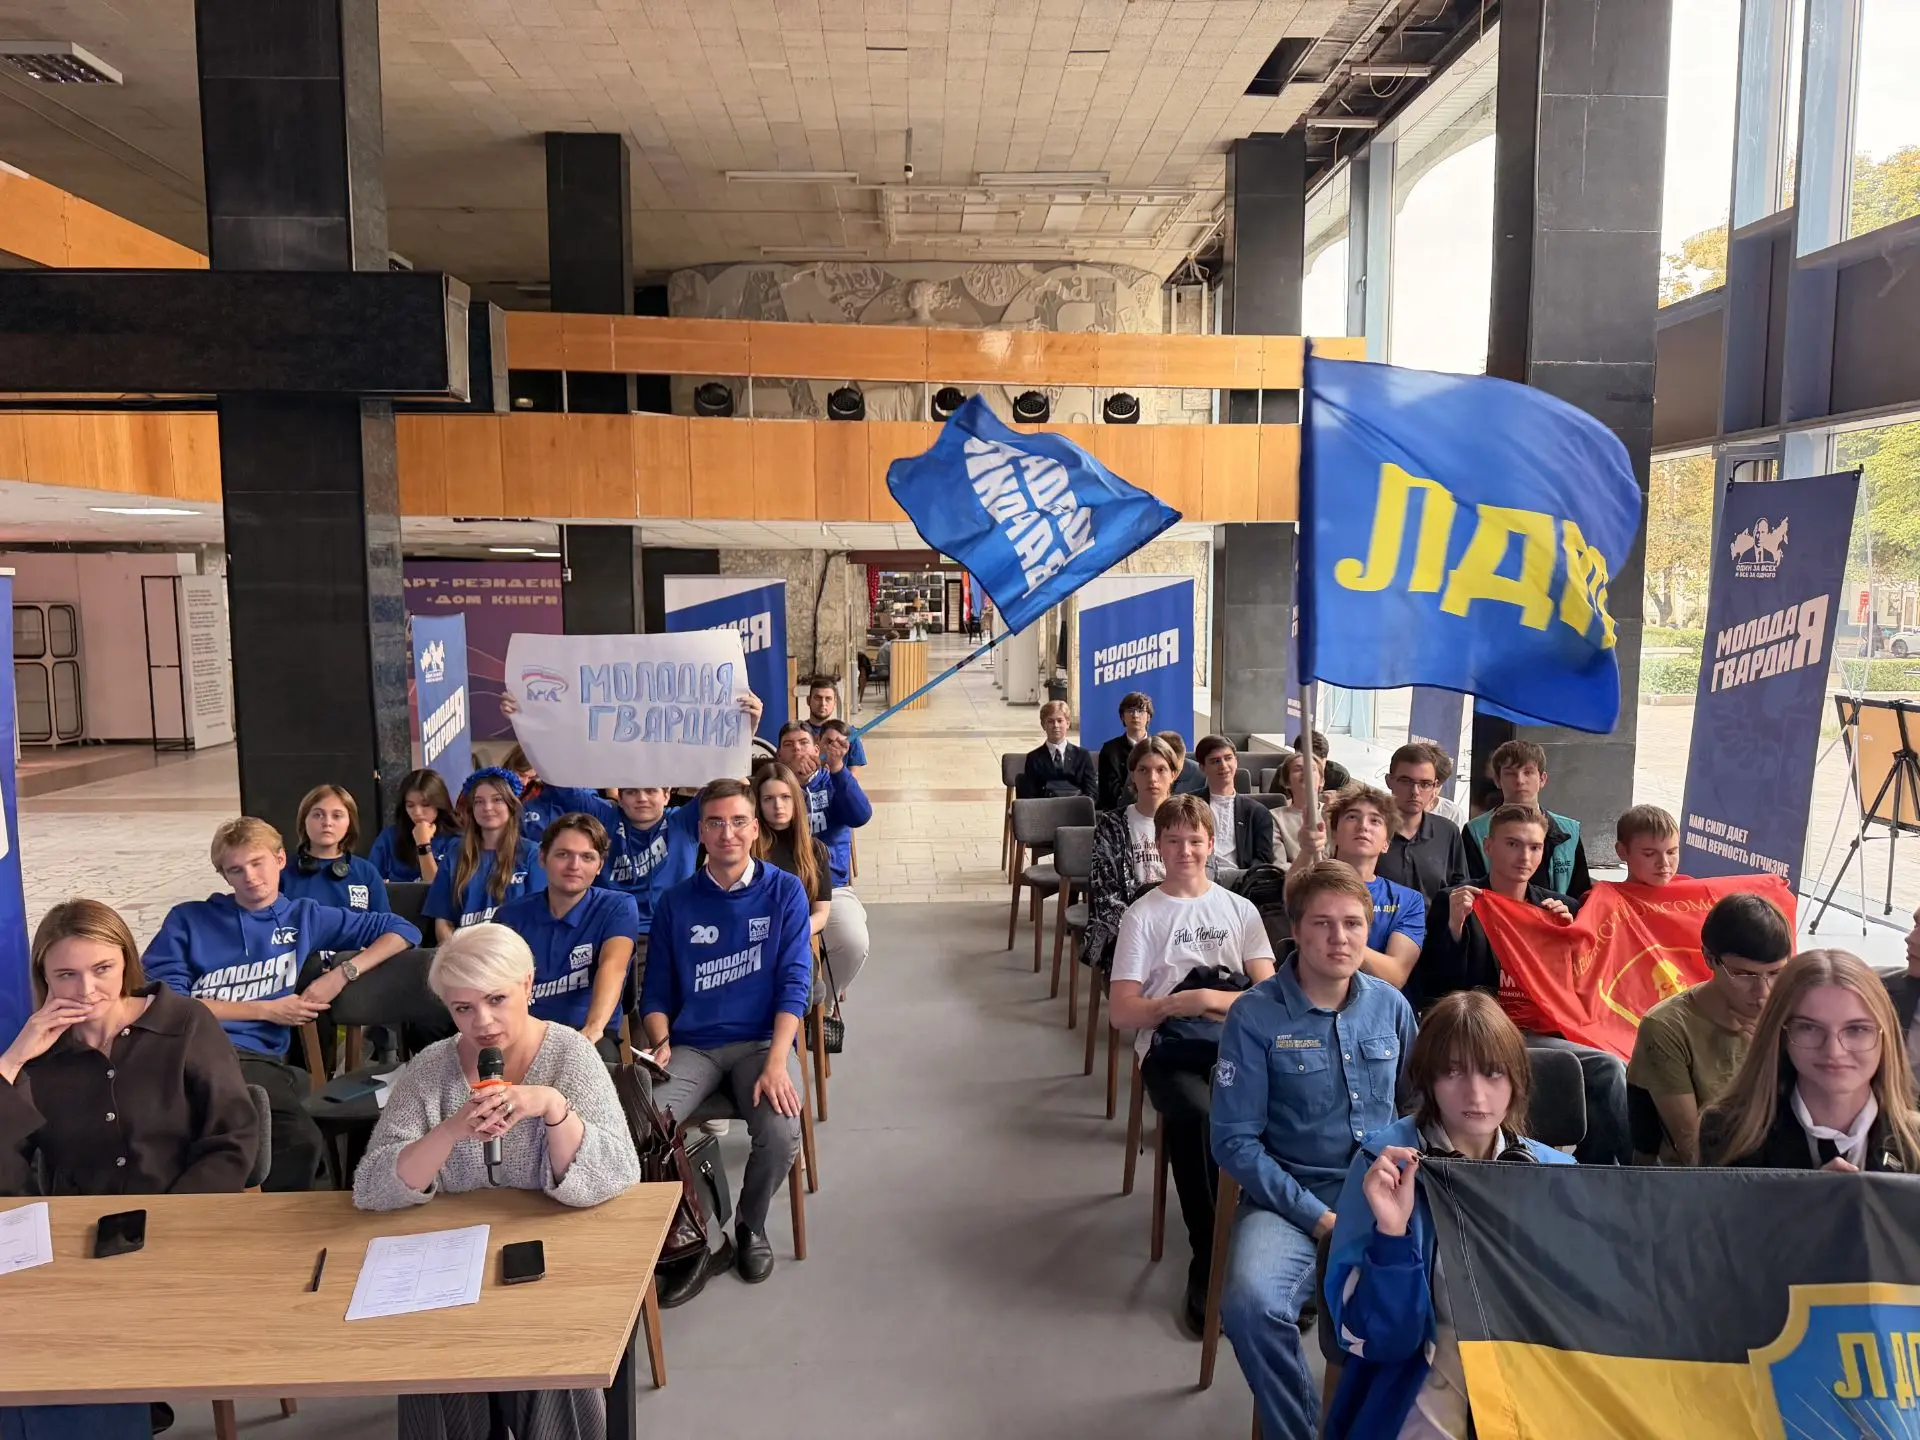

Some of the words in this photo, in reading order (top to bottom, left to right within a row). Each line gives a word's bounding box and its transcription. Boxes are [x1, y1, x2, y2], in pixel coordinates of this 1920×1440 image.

[1761, 564, 1776, 572] ВСЕХ
[1716, 594, 1829, 659] МОЛОДАЯ
[1095, 628, 1179, 667] МОЛОДАЯ
[580, 662, 733, 705] МОЛОДАЯ
[588, 704, 742, 748] ГВАРДИЯ
[1688, 813, 1705, 831] НАМ
[1705, 819, 1727, 837] СИЛУ
[1726, 825, 1749, 844] ДАЕТ
[1686, 831, 1708, 850] НАША
[1708, 838, 1749, 865] ВЕРНОСТЬ
[1749, 852, 1790, 878] ОТЧИЗНЕ
[690, 925, 719, 944] 20
[1174, 928, 1193, 945] Fila
[191, 950, 296, 990] МОЛОДАЯ
[695, 943, 762, 977] МОЛОДАЯ
